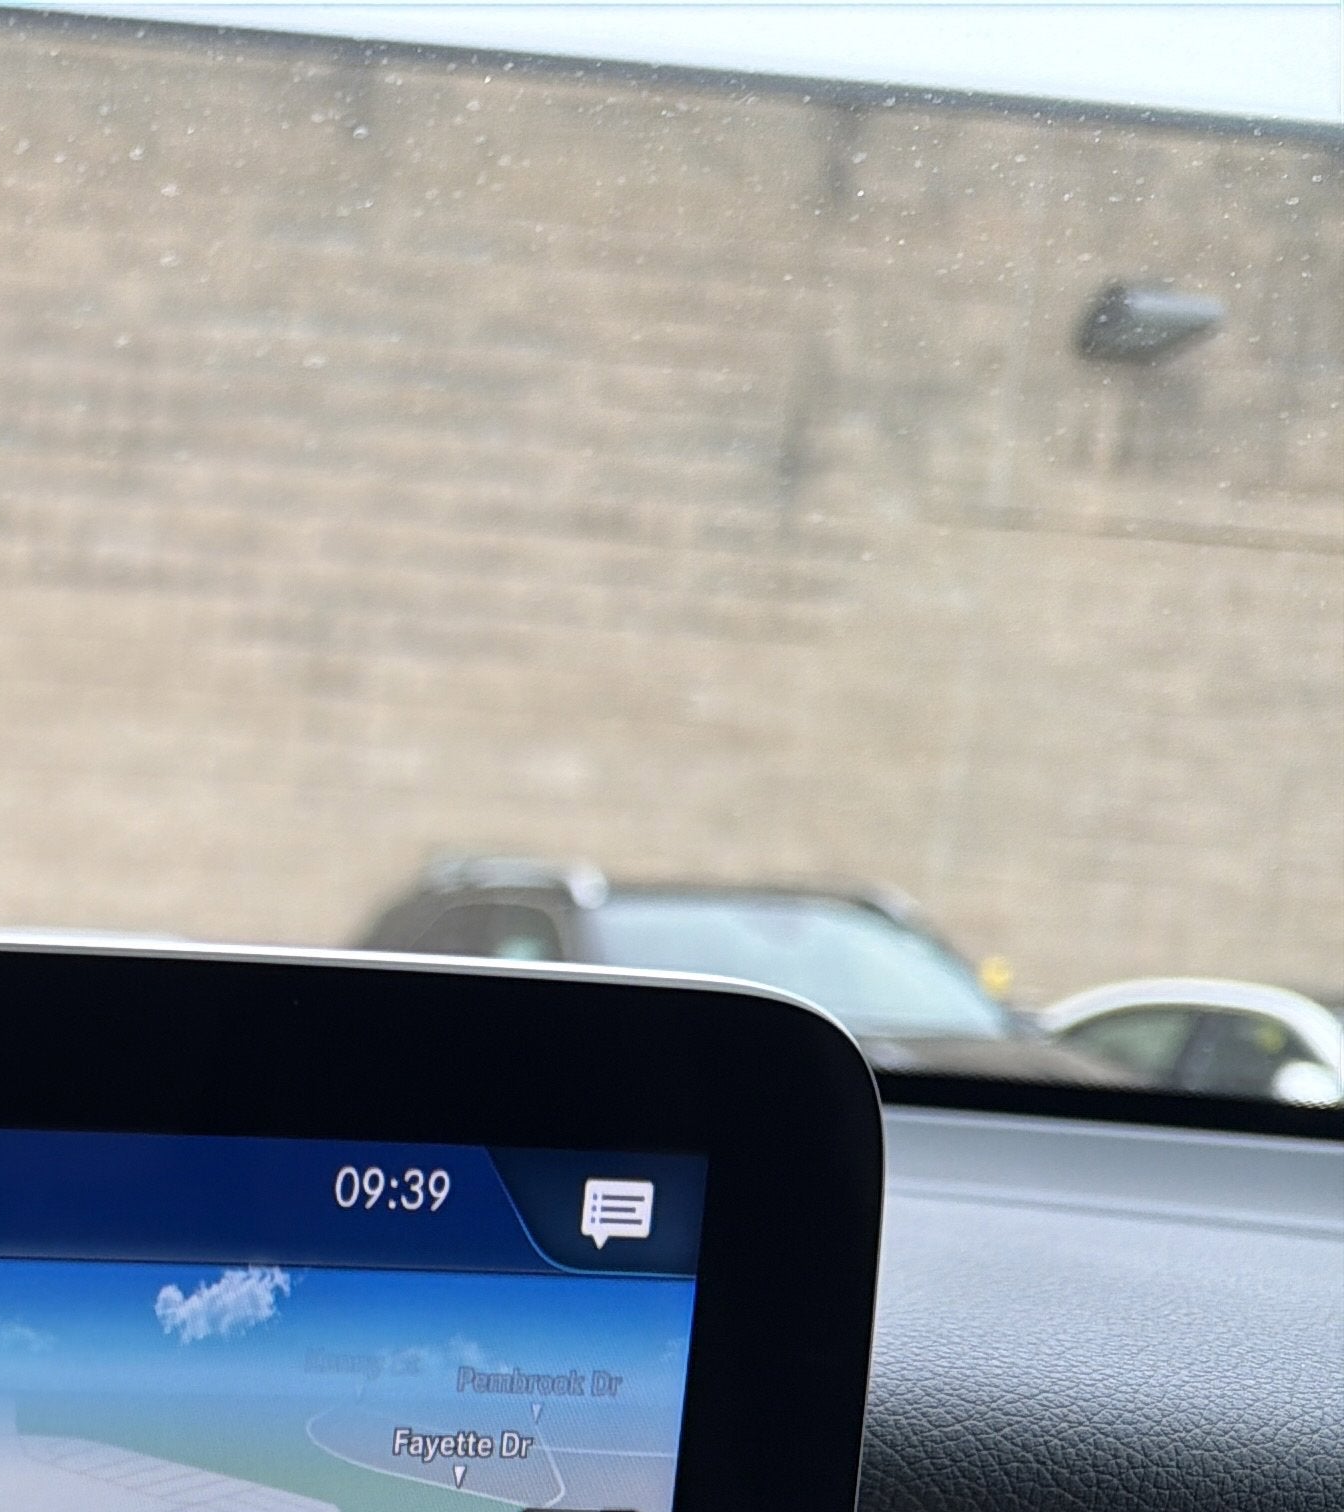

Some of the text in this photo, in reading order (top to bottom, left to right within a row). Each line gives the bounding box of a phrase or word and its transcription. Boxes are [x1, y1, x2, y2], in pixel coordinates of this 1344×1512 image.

[334, 1166, 451, 1211] 09:39
[456, 1367, 623, 1398] Pembrook Dr
[393, 1429, 533, 1466] Fayette Dr
